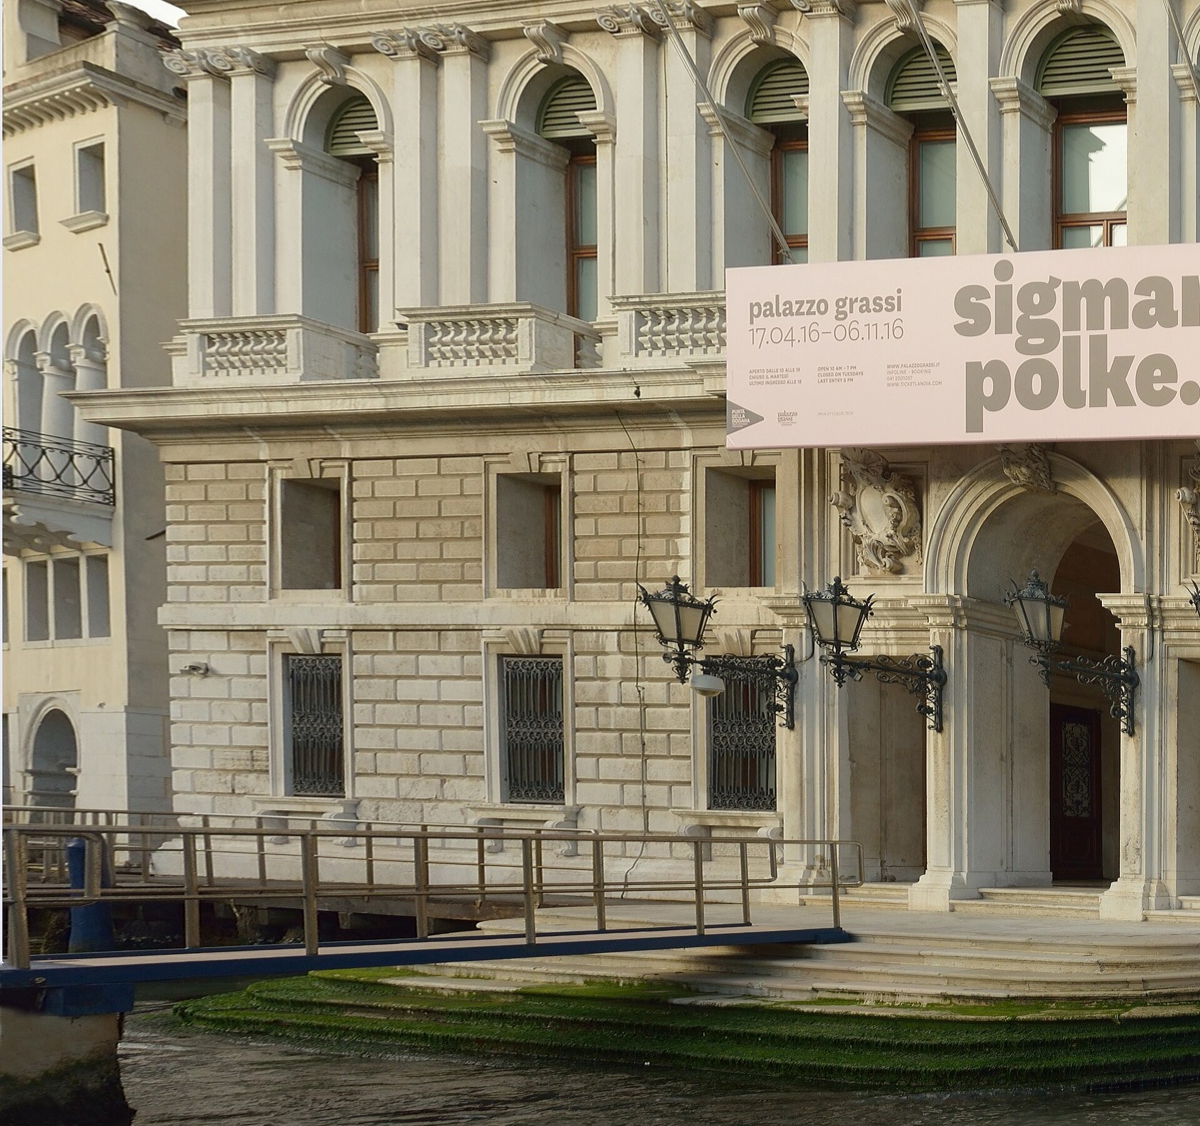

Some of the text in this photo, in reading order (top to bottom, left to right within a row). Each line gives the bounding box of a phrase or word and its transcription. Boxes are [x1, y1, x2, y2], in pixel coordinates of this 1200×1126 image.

[749, 288, 902, 325] palazzo grassi
[965, 334, 1200, 433] polke.
